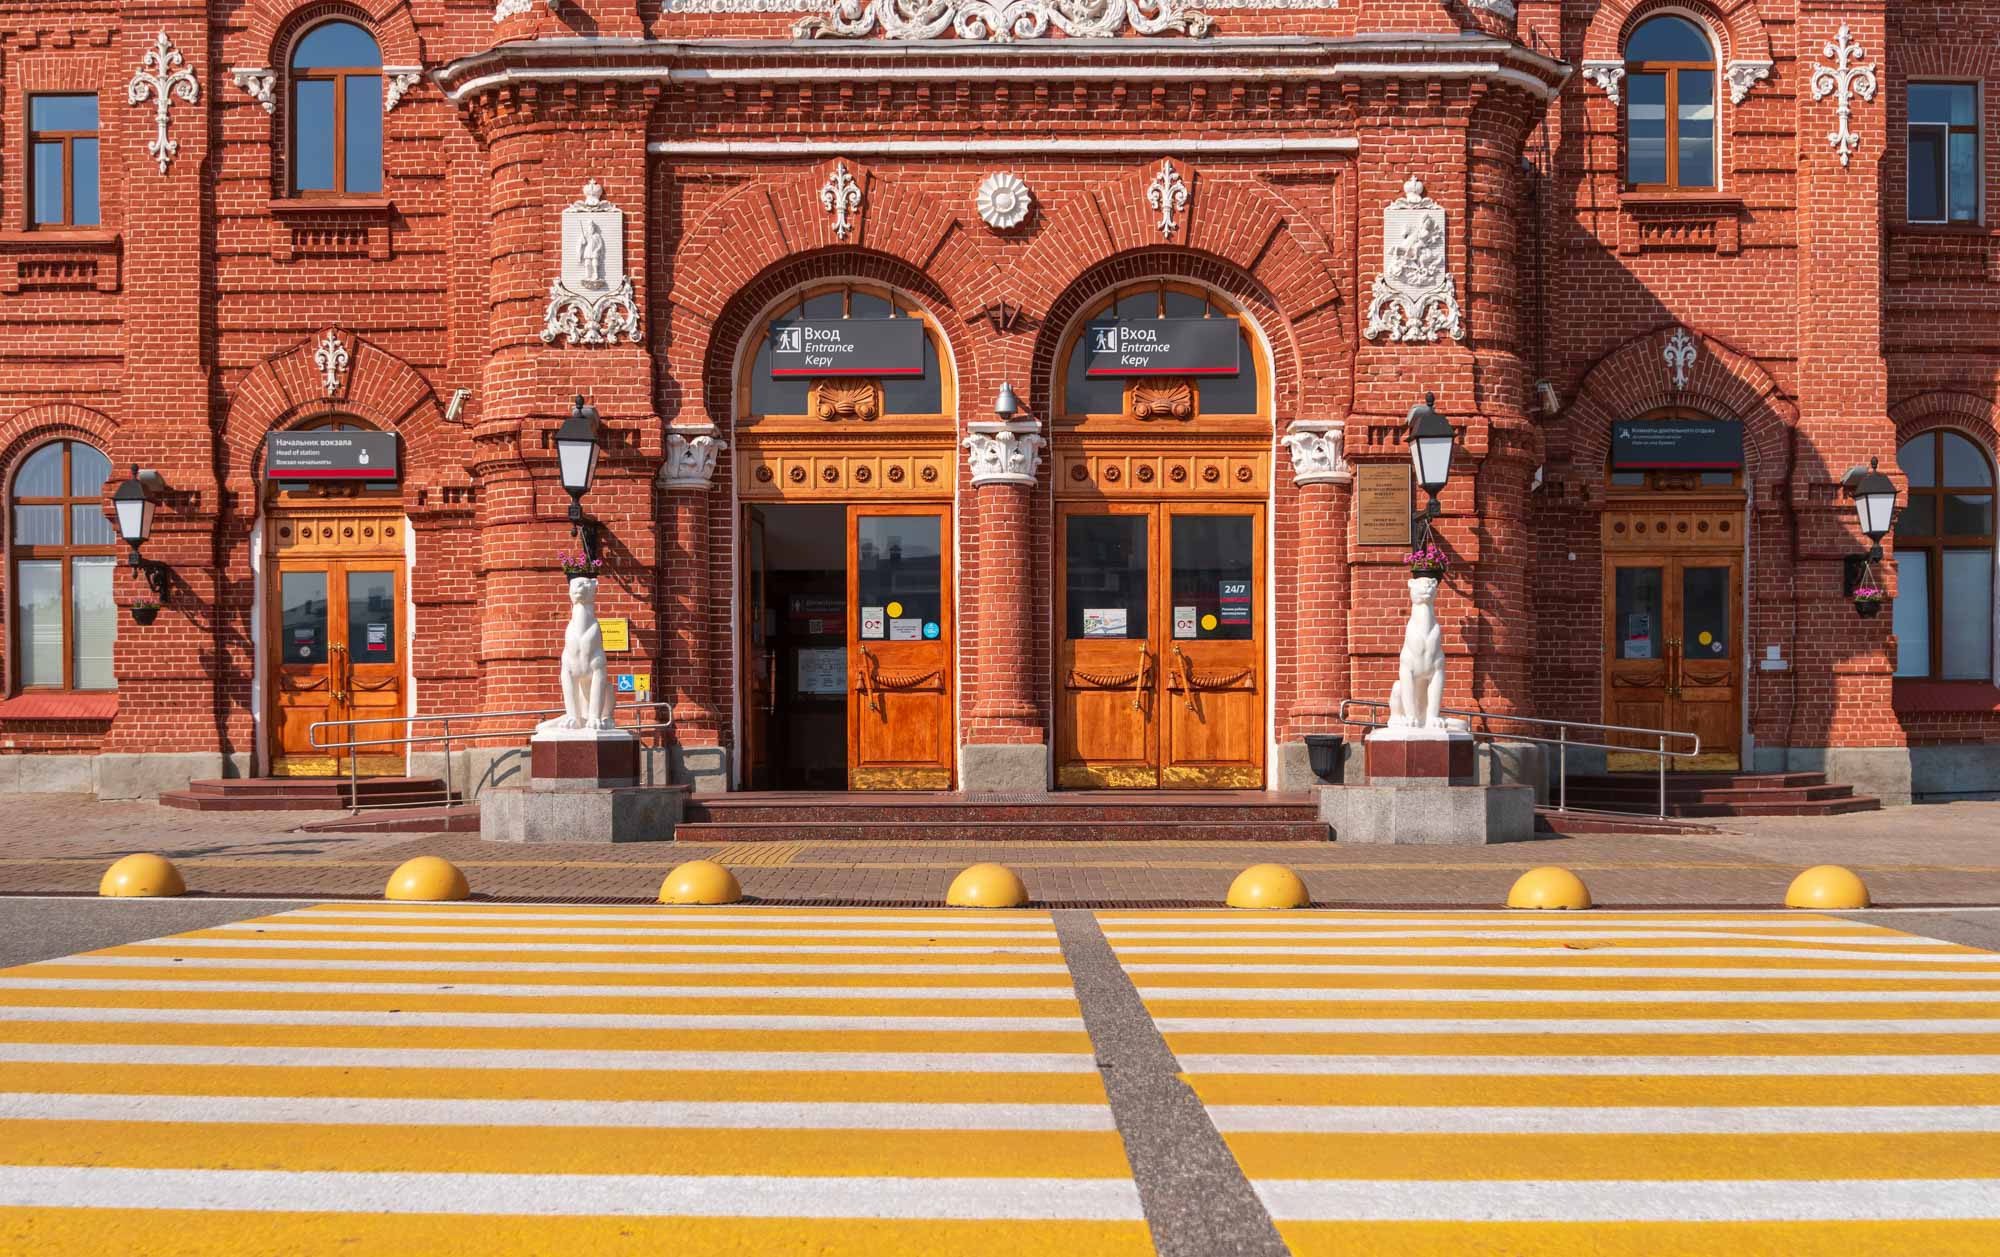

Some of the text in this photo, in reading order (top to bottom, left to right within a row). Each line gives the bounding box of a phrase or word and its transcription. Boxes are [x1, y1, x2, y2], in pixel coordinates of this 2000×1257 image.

[804, 327, 841, 342] Вход
[1120, 327, 1157, 342] Вход
[805, 342, 855, 353] Entrance
[1121, 342, 1171, 353] Entrance
[1224, 584, 1246, 594] 24/7
